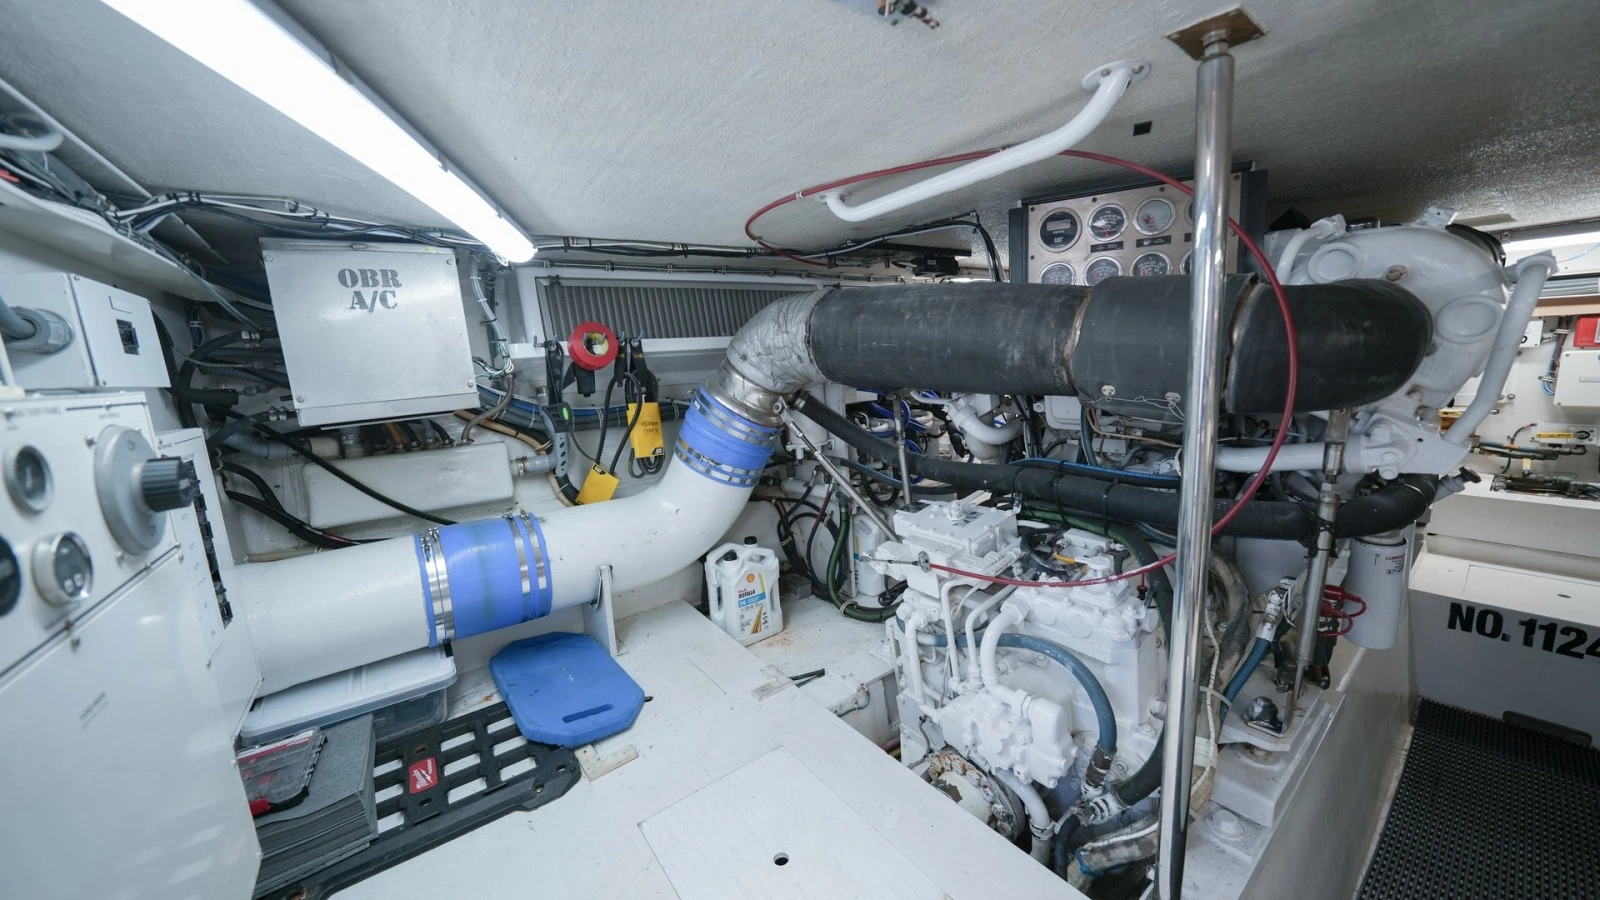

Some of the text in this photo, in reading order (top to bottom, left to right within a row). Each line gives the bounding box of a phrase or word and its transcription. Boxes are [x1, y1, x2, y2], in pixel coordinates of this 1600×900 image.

[338, 268, 402, 288] OBR
[349, 290, 397, 313] A/C
[738, 590, 756, 598] ROTELLA
[1447, 602, 1511, 643] NO.
